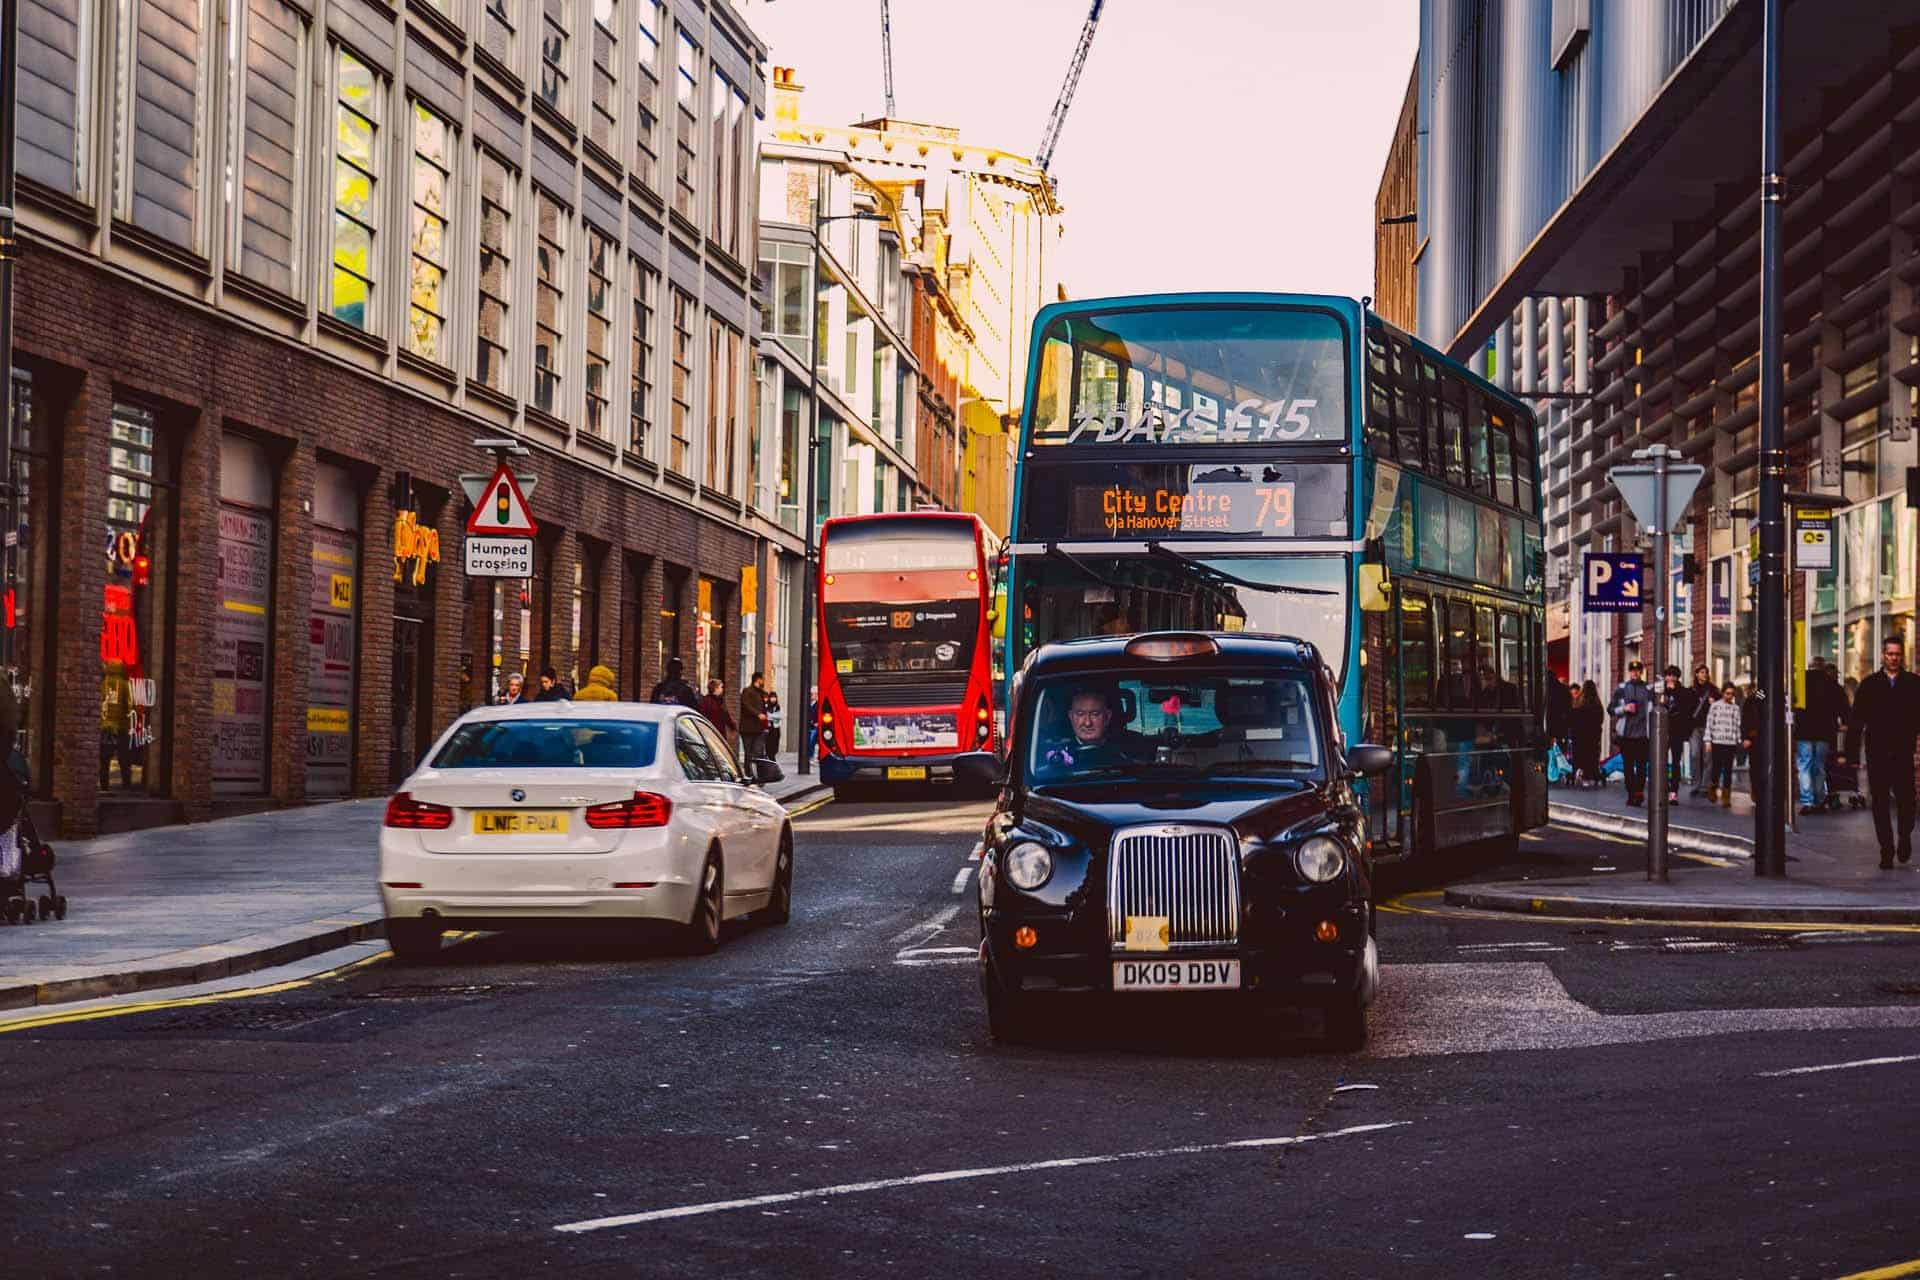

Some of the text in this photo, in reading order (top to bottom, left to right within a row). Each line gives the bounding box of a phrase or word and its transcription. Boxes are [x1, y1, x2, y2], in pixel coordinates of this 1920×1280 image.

[1068, 399, 1317, 443] 7 DAYS £15
[1103, 488, 1231, 513] City Centre
[1254, 487, 1292, 528] 79
[1104, 515, 1230, 529] via Hanover Street
[471, 542, 528, 556] Humped
[471, 558, 528, 572] crossing
[1589, 560, 1612, 596] P
[1123, 963, 1231, 985] DK09 DBV
